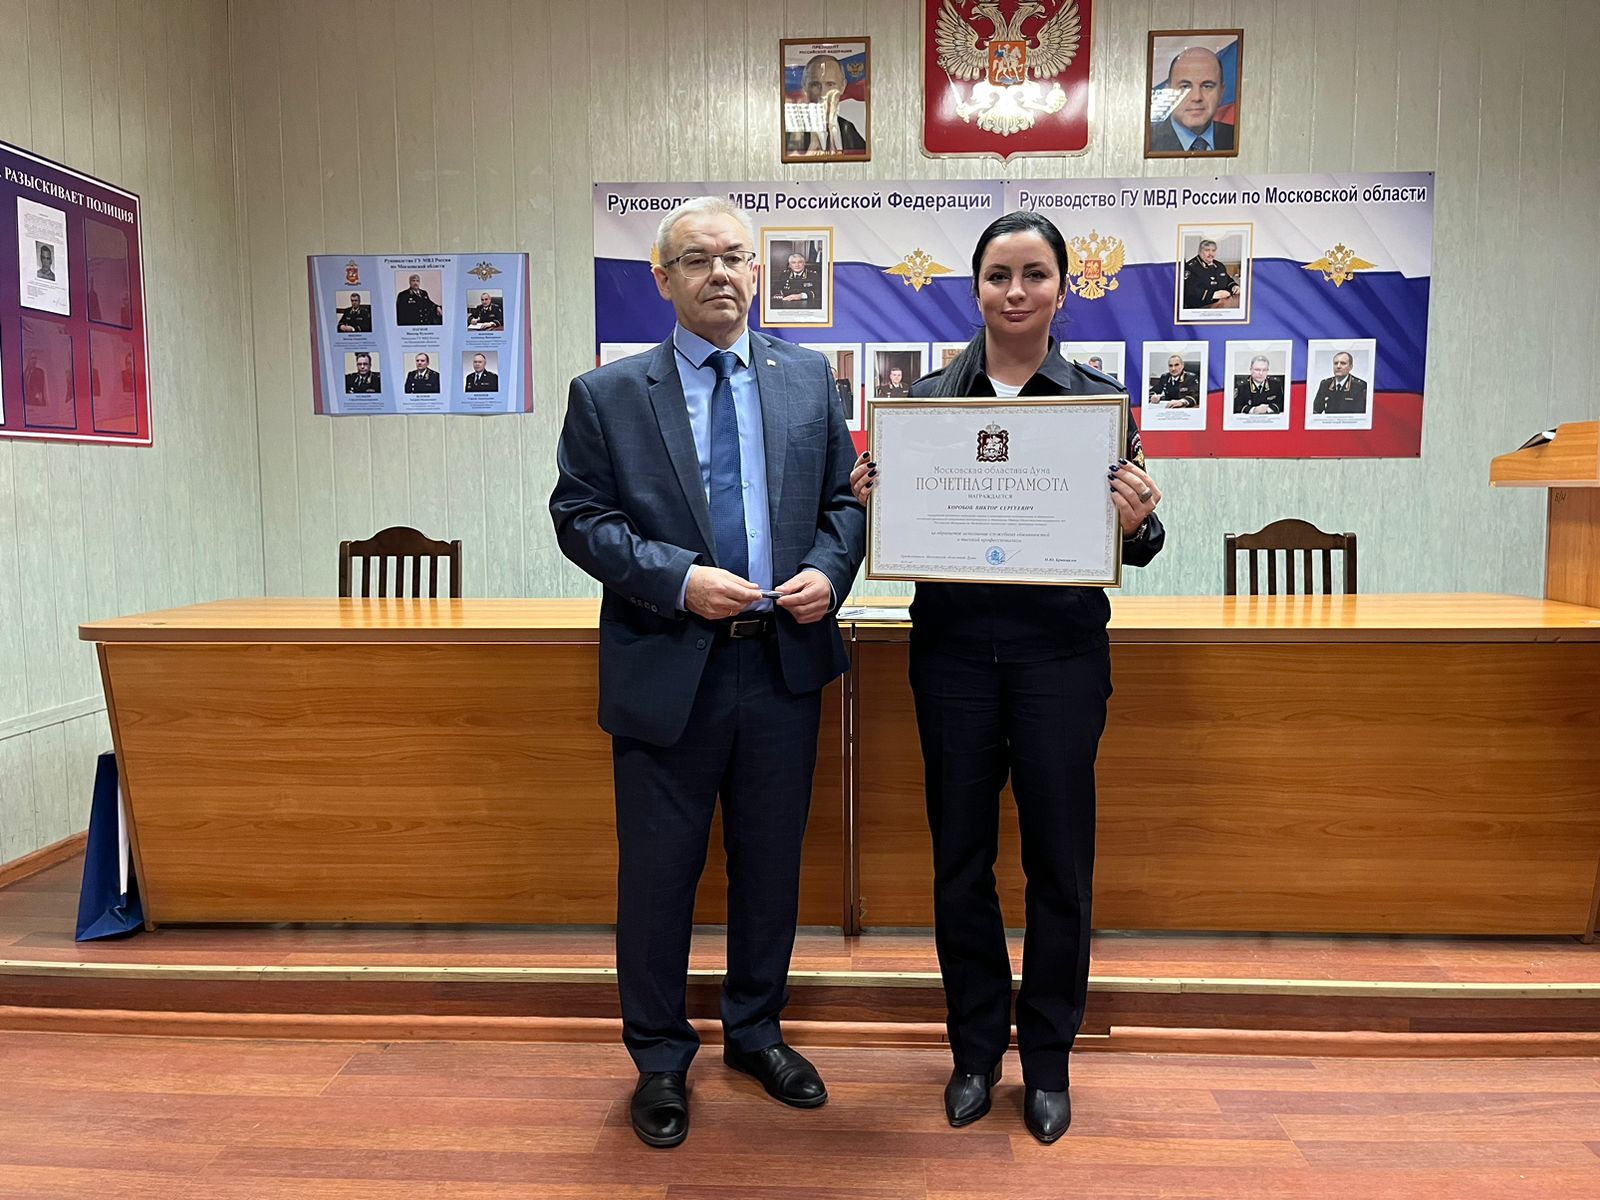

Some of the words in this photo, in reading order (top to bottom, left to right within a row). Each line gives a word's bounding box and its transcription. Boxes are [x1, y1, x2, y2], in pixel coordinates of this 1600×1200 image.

[5, 167, 85, 206] РАЗЫСКИВАЕТ
[87, 196, 134, 224] ПОЛИЦИЯ
[729, 194, 769, 211] МВД
[775, 191, 882, 210] Российской
[888, 191, 991, 212] Федерации
[1019, 191, 1116, 212] Руководство
[1121, 190, 1139, 206] ГУ
[1143, 189, 1177, 208] МВД
[1182, 188, 1238, 206] России
[1242, 192, 1261, 204] по
[1265, 185, 1359, 204] Московской
[1363, 185, 1426, 202] области
[933, 466, 983, 475] Московская
[984, 466, 1028, 475] областная
[1029, 467, 1051, 476] Дума
[916, 476, 992, 491] ПОЧЕТНАЯ
[997, 477, 1069, 492] ГРАМОТА
